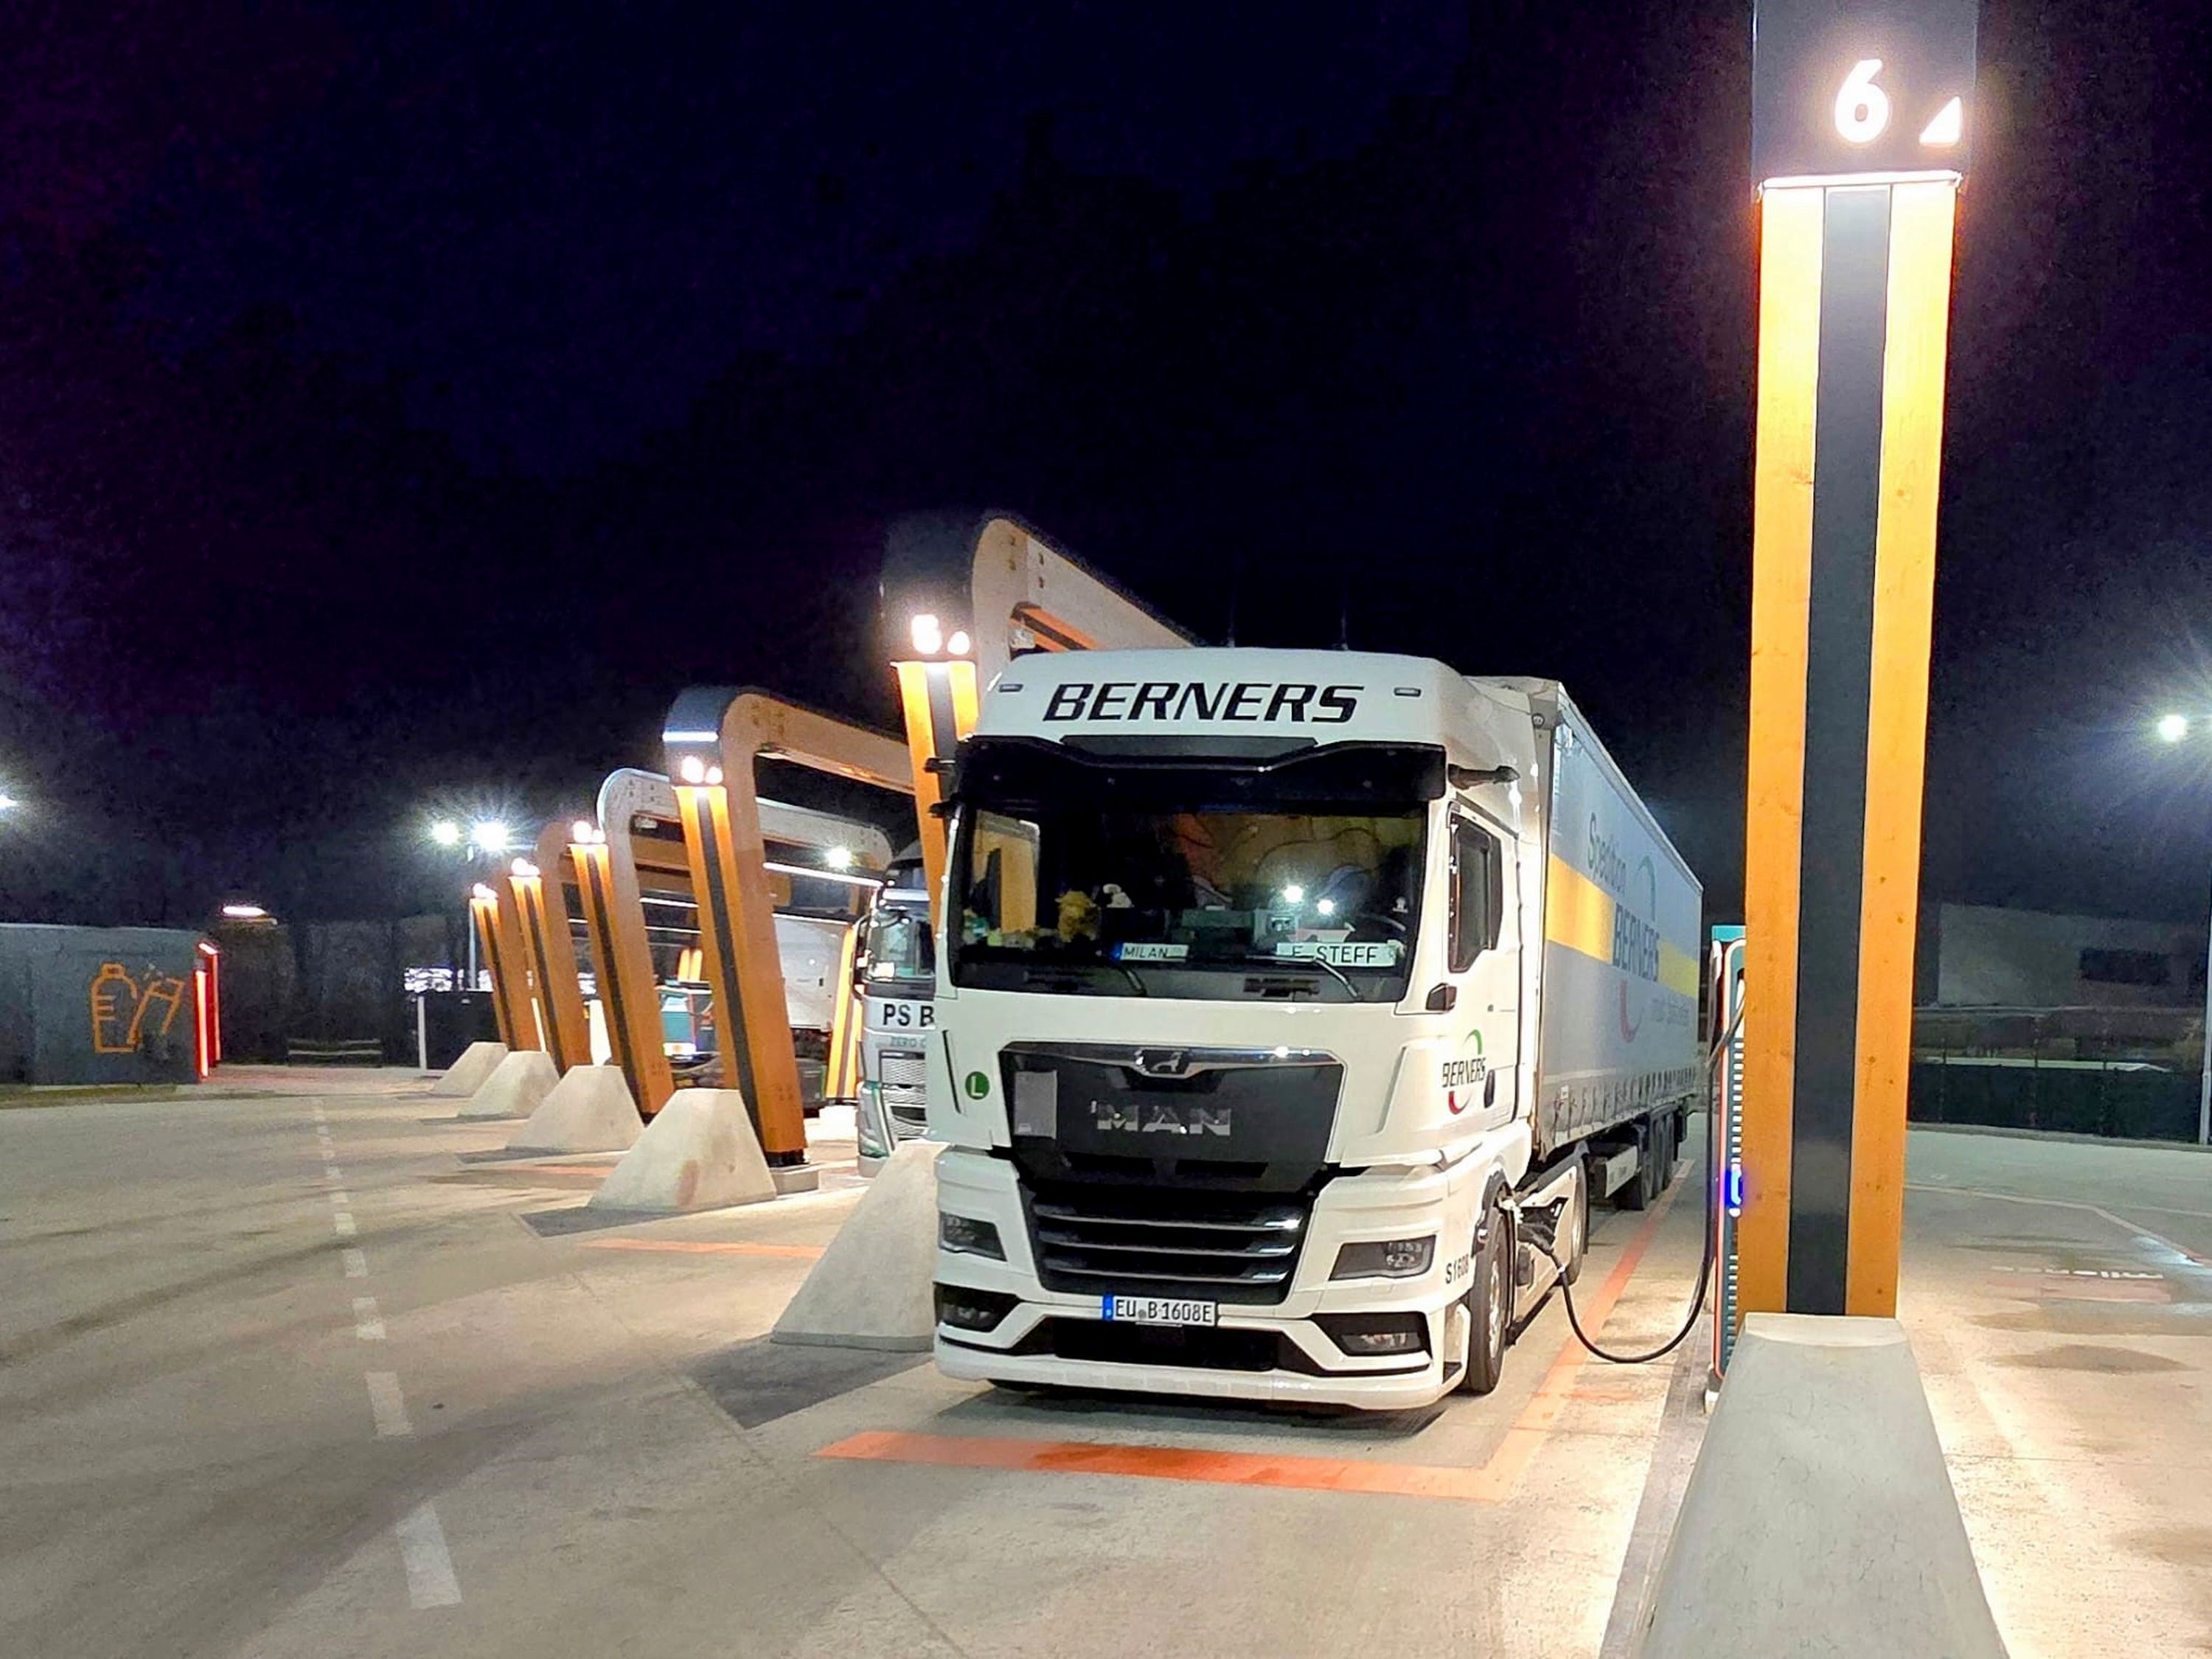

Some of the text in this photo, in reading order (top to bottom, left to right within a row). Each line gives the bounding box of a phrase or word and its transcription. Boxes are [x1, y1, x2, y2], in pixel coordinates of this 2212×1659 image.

[1834, 58, 1890, 144] 6
[1042, 682, 1365, 723] BERNERS
[1124, 946, 1169, 959] MILAN
[1317, 945, 1379, 964] STEFF
[1613, 902, 1660, 982] BERNERS
[883, 1004, 911, 1026] PS
[1442, 1057, 1486, 1088] BERNERS
[970, 1075, 984, 1097] L
[1096, 1104, 1231, 1137] MAN
[1116, 1298, 1137, 1318] EU
